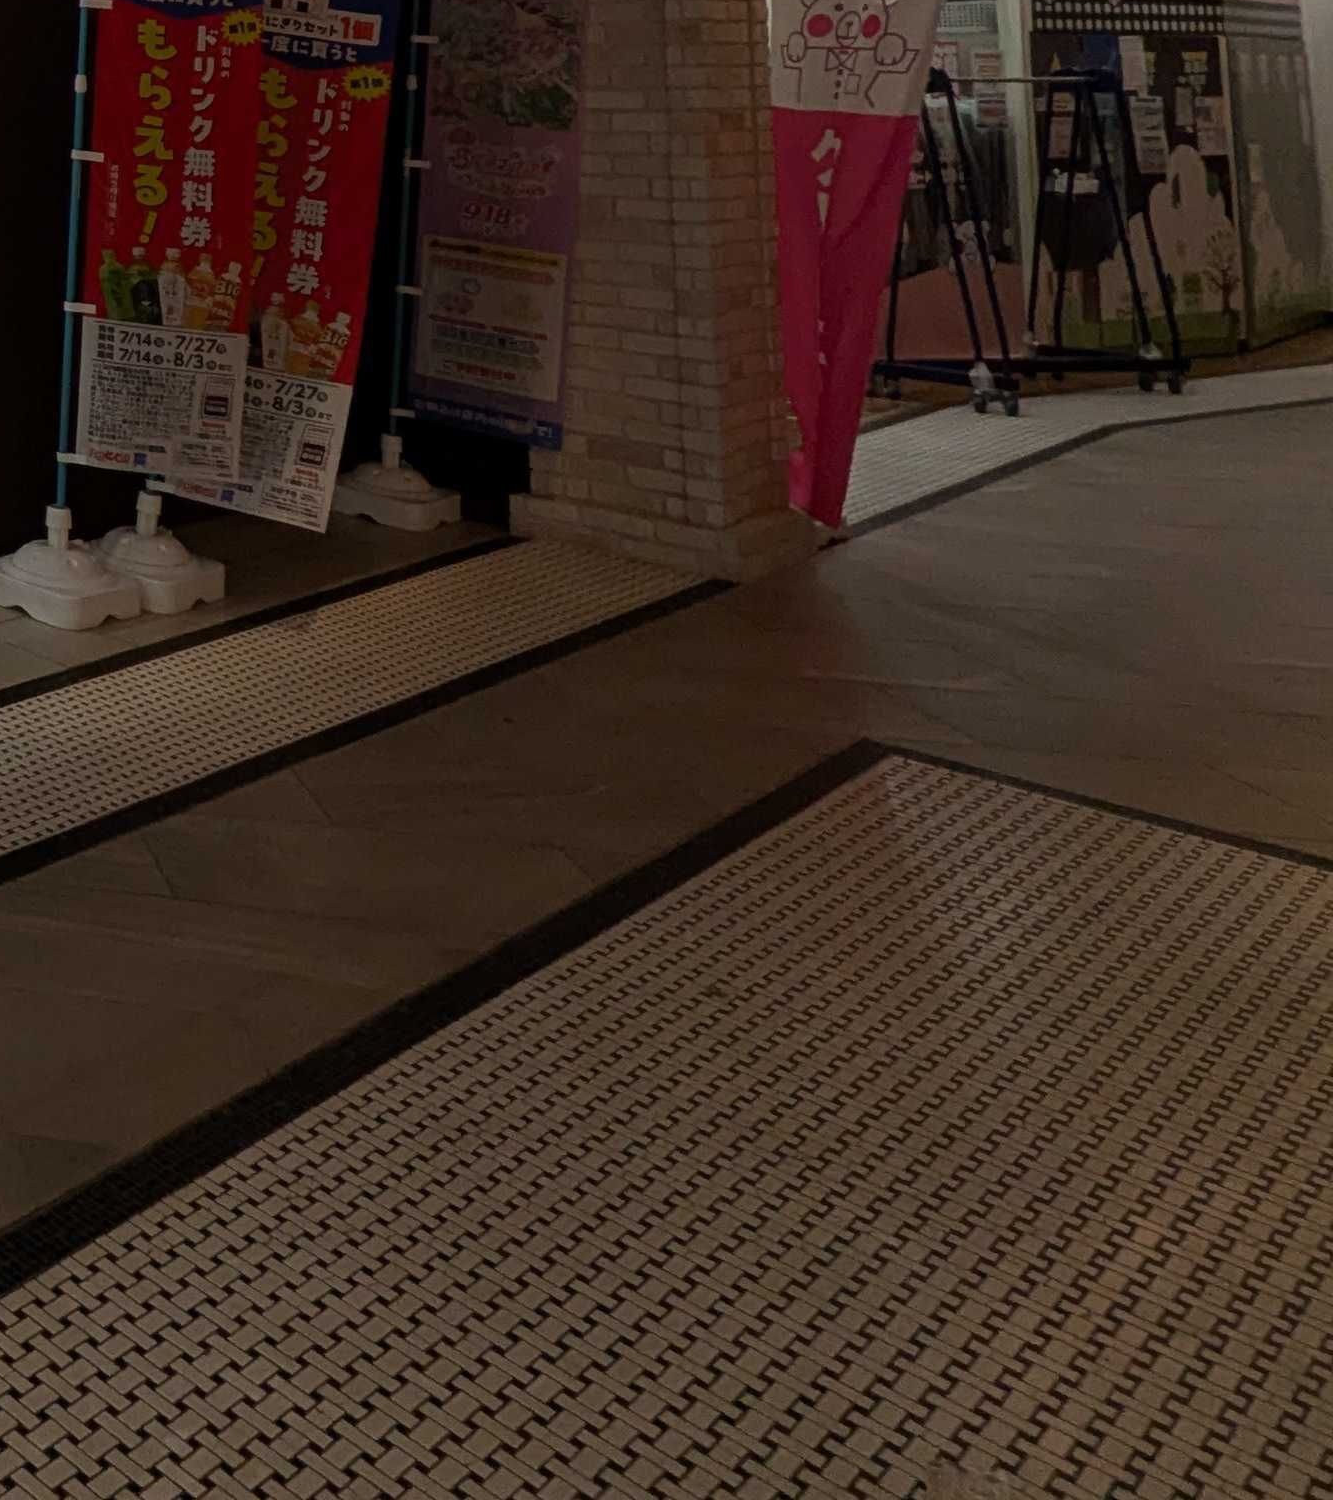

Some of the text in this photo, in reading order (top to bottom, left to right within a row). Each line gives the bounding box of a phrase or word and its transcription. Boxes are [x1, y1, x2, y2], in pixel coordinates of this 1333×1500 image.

[180, 24, 220, 248] ドリンク無料券
[265, 16, 338, 37] にぎりセット
[286, 76, 338, 296] ドリンク無料券
